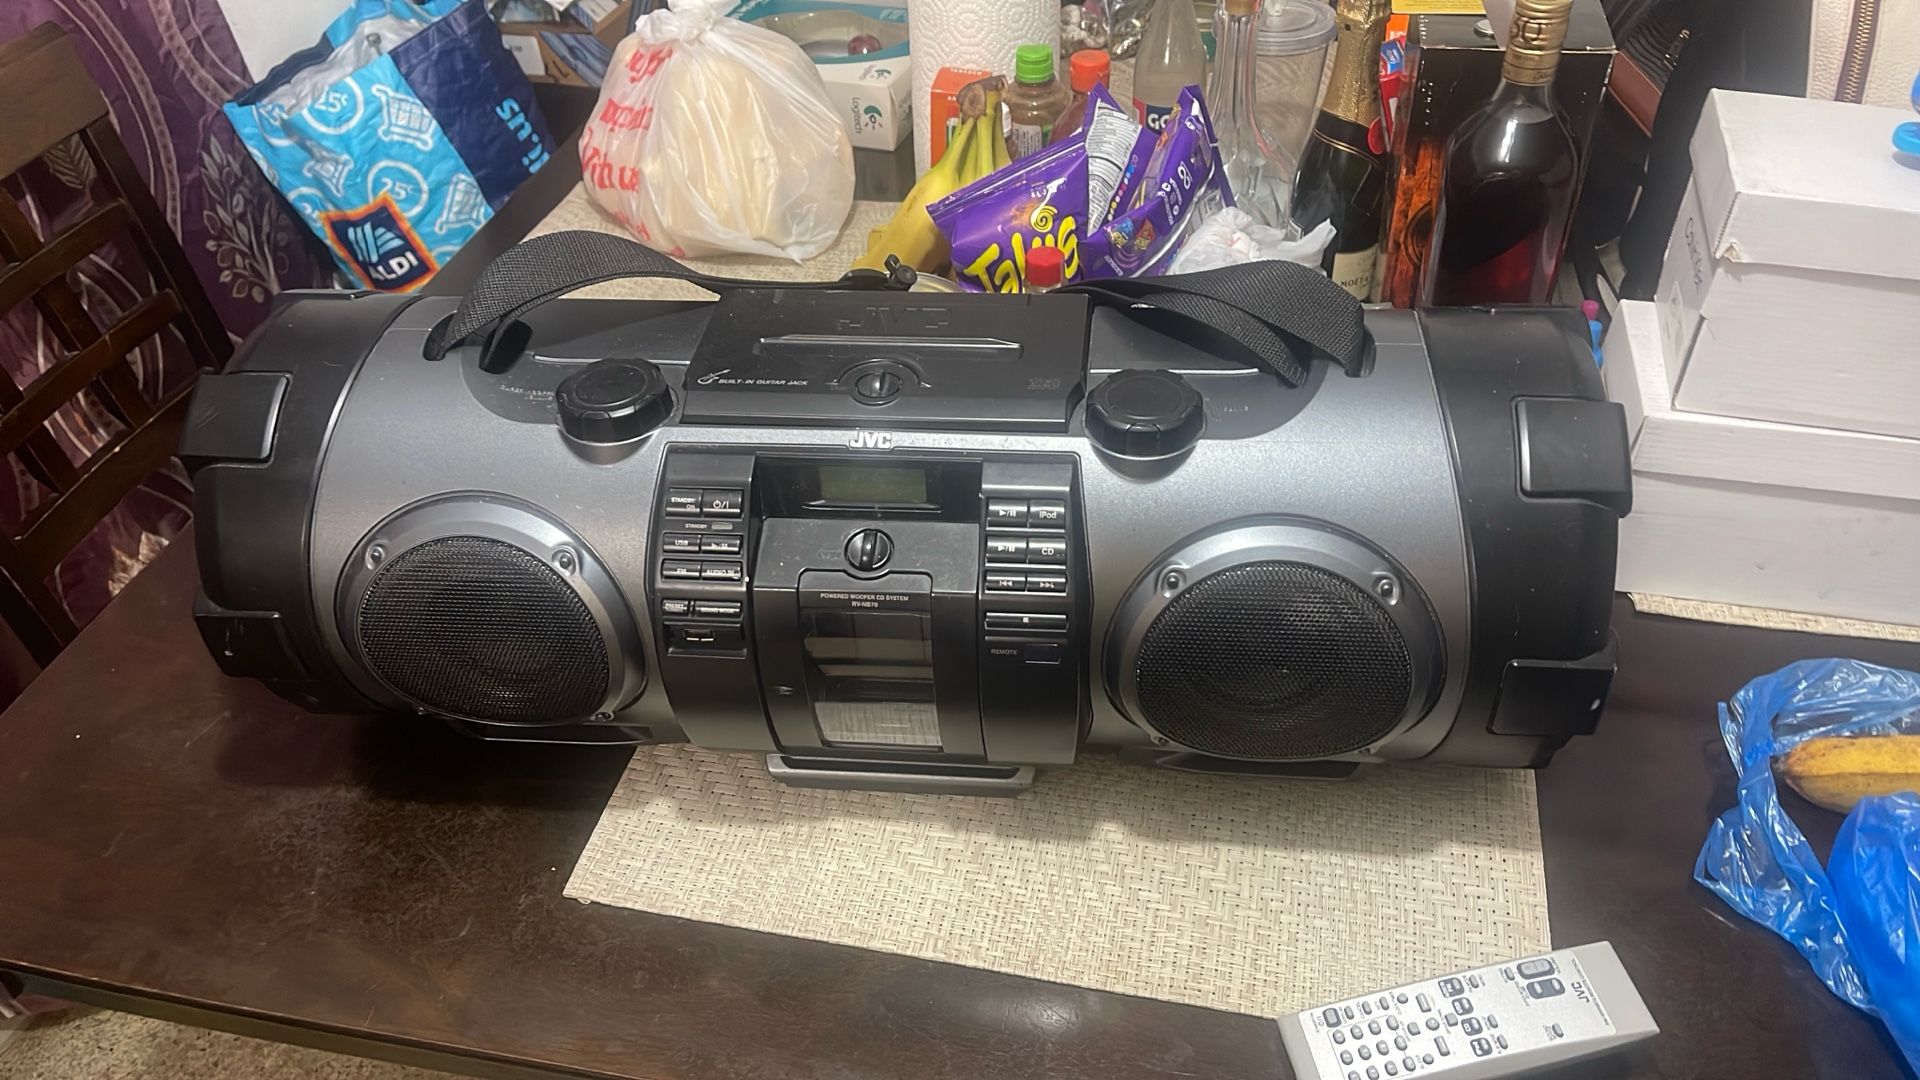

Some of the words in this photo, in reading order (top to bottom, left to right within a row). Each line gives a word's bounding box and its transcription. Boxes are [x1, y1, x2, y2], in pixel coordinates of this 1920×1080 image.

[368, 251, 418, 281] ALDI
[849, 431, 892, 448] JVC
[1041, 547, 1055, 557] CD
[990, 648, 1018, 656] REMOTE
[1571, 981, 1590, 1003] JVC
